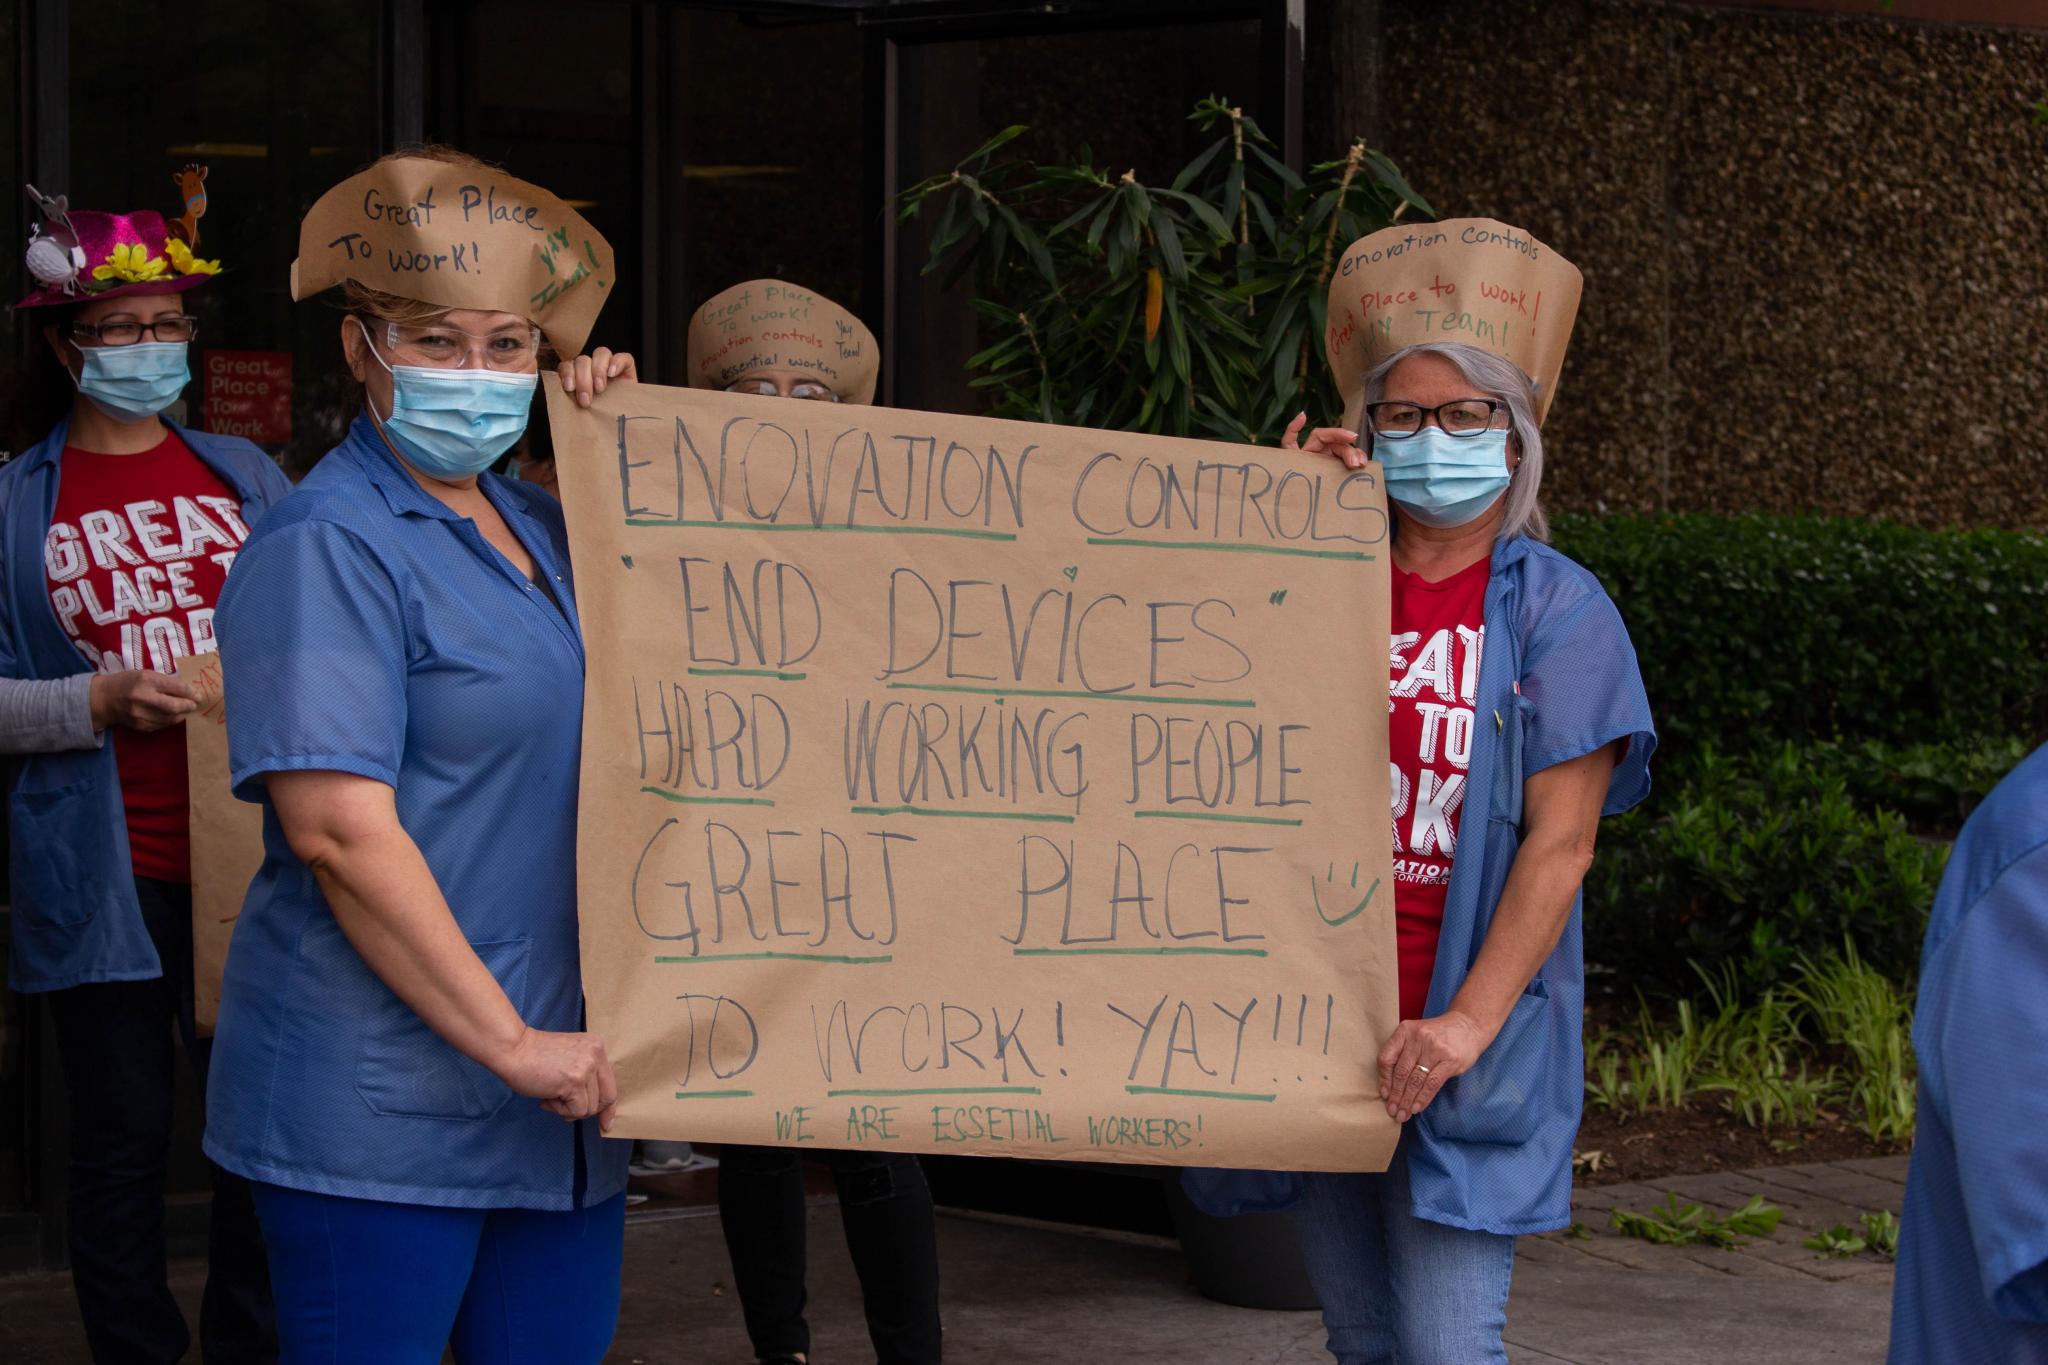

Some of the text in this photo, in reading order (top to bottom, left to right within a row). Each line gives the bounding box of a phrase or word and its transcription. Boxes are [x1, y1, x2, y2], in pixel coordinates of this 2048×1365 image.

[364, 185, 544, 231] Great Place
[328, 233, 372, 261] To
[702, 286, 816, 326] Great Place
[1429, 275, 1457, 298] to
[762, 328, 824, 349] controls
[209, 356, 271, 375] Great
[210, 376, 270, 395] Place
[721, 353, 838, 380] essential workers
[617, 413, 1388, 545] ENOVATION CONTROLS
[45, 495, 252, 583] GREAT
[51, 560, 204, 637] PLACE
[633, 676, 1312, 815] HARD WORKING PEOPLE
[1415, 701, 1476, 769] TO
[632, 818, 1274, 956] GREAT PLACE
[1392, 858, 1451, 878] ATION
[676, 992, 759, 1087] TO
[1107, 994, 1334, 1088] YAY!!!
[776, 1106, 815, 1142] WE
[848, 1104, 902, 1142] ARE
[1089, 1113, 1204, 1149] WORKERS!
